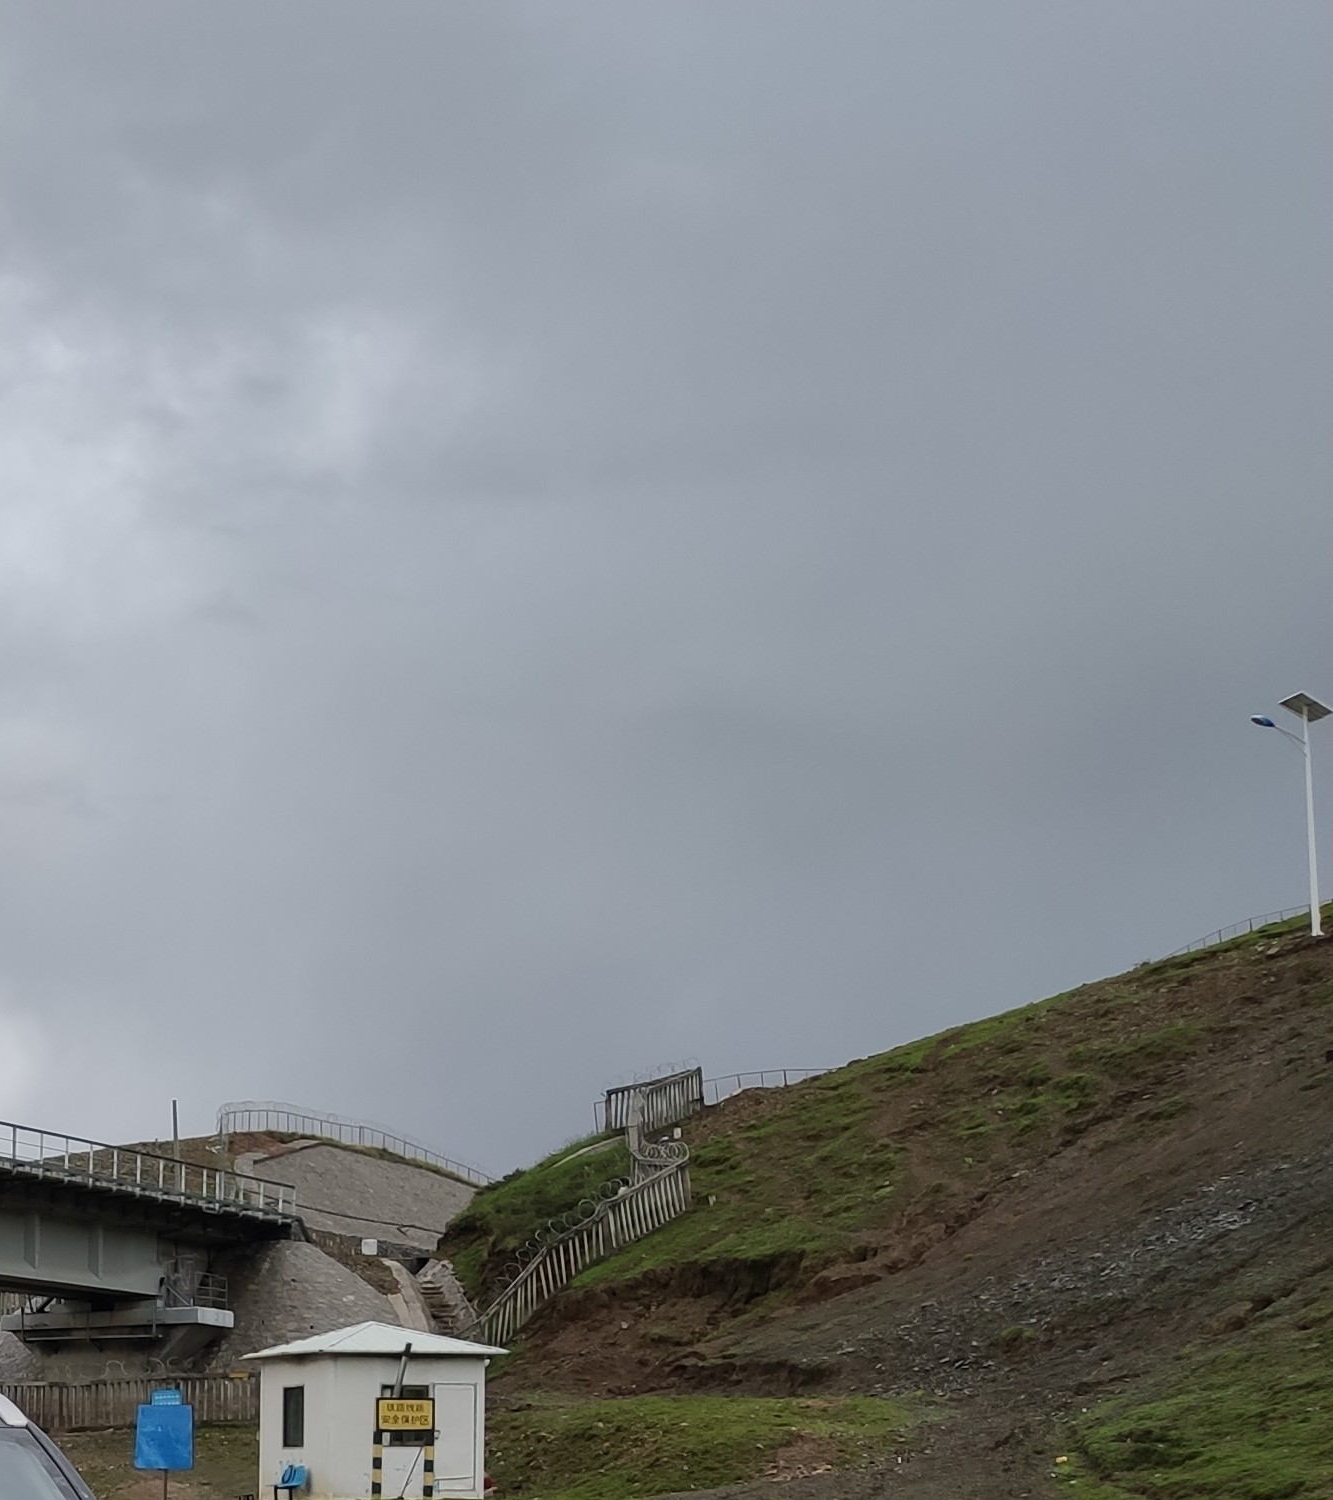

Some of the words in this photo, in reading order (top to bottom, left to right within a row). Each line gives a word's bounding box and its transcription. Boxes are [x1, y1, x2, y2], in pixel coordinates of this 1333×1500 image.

[386, 1402, 425, 1413] 铁路线路
[381, 1414, 429, 1426] 安全保护区
